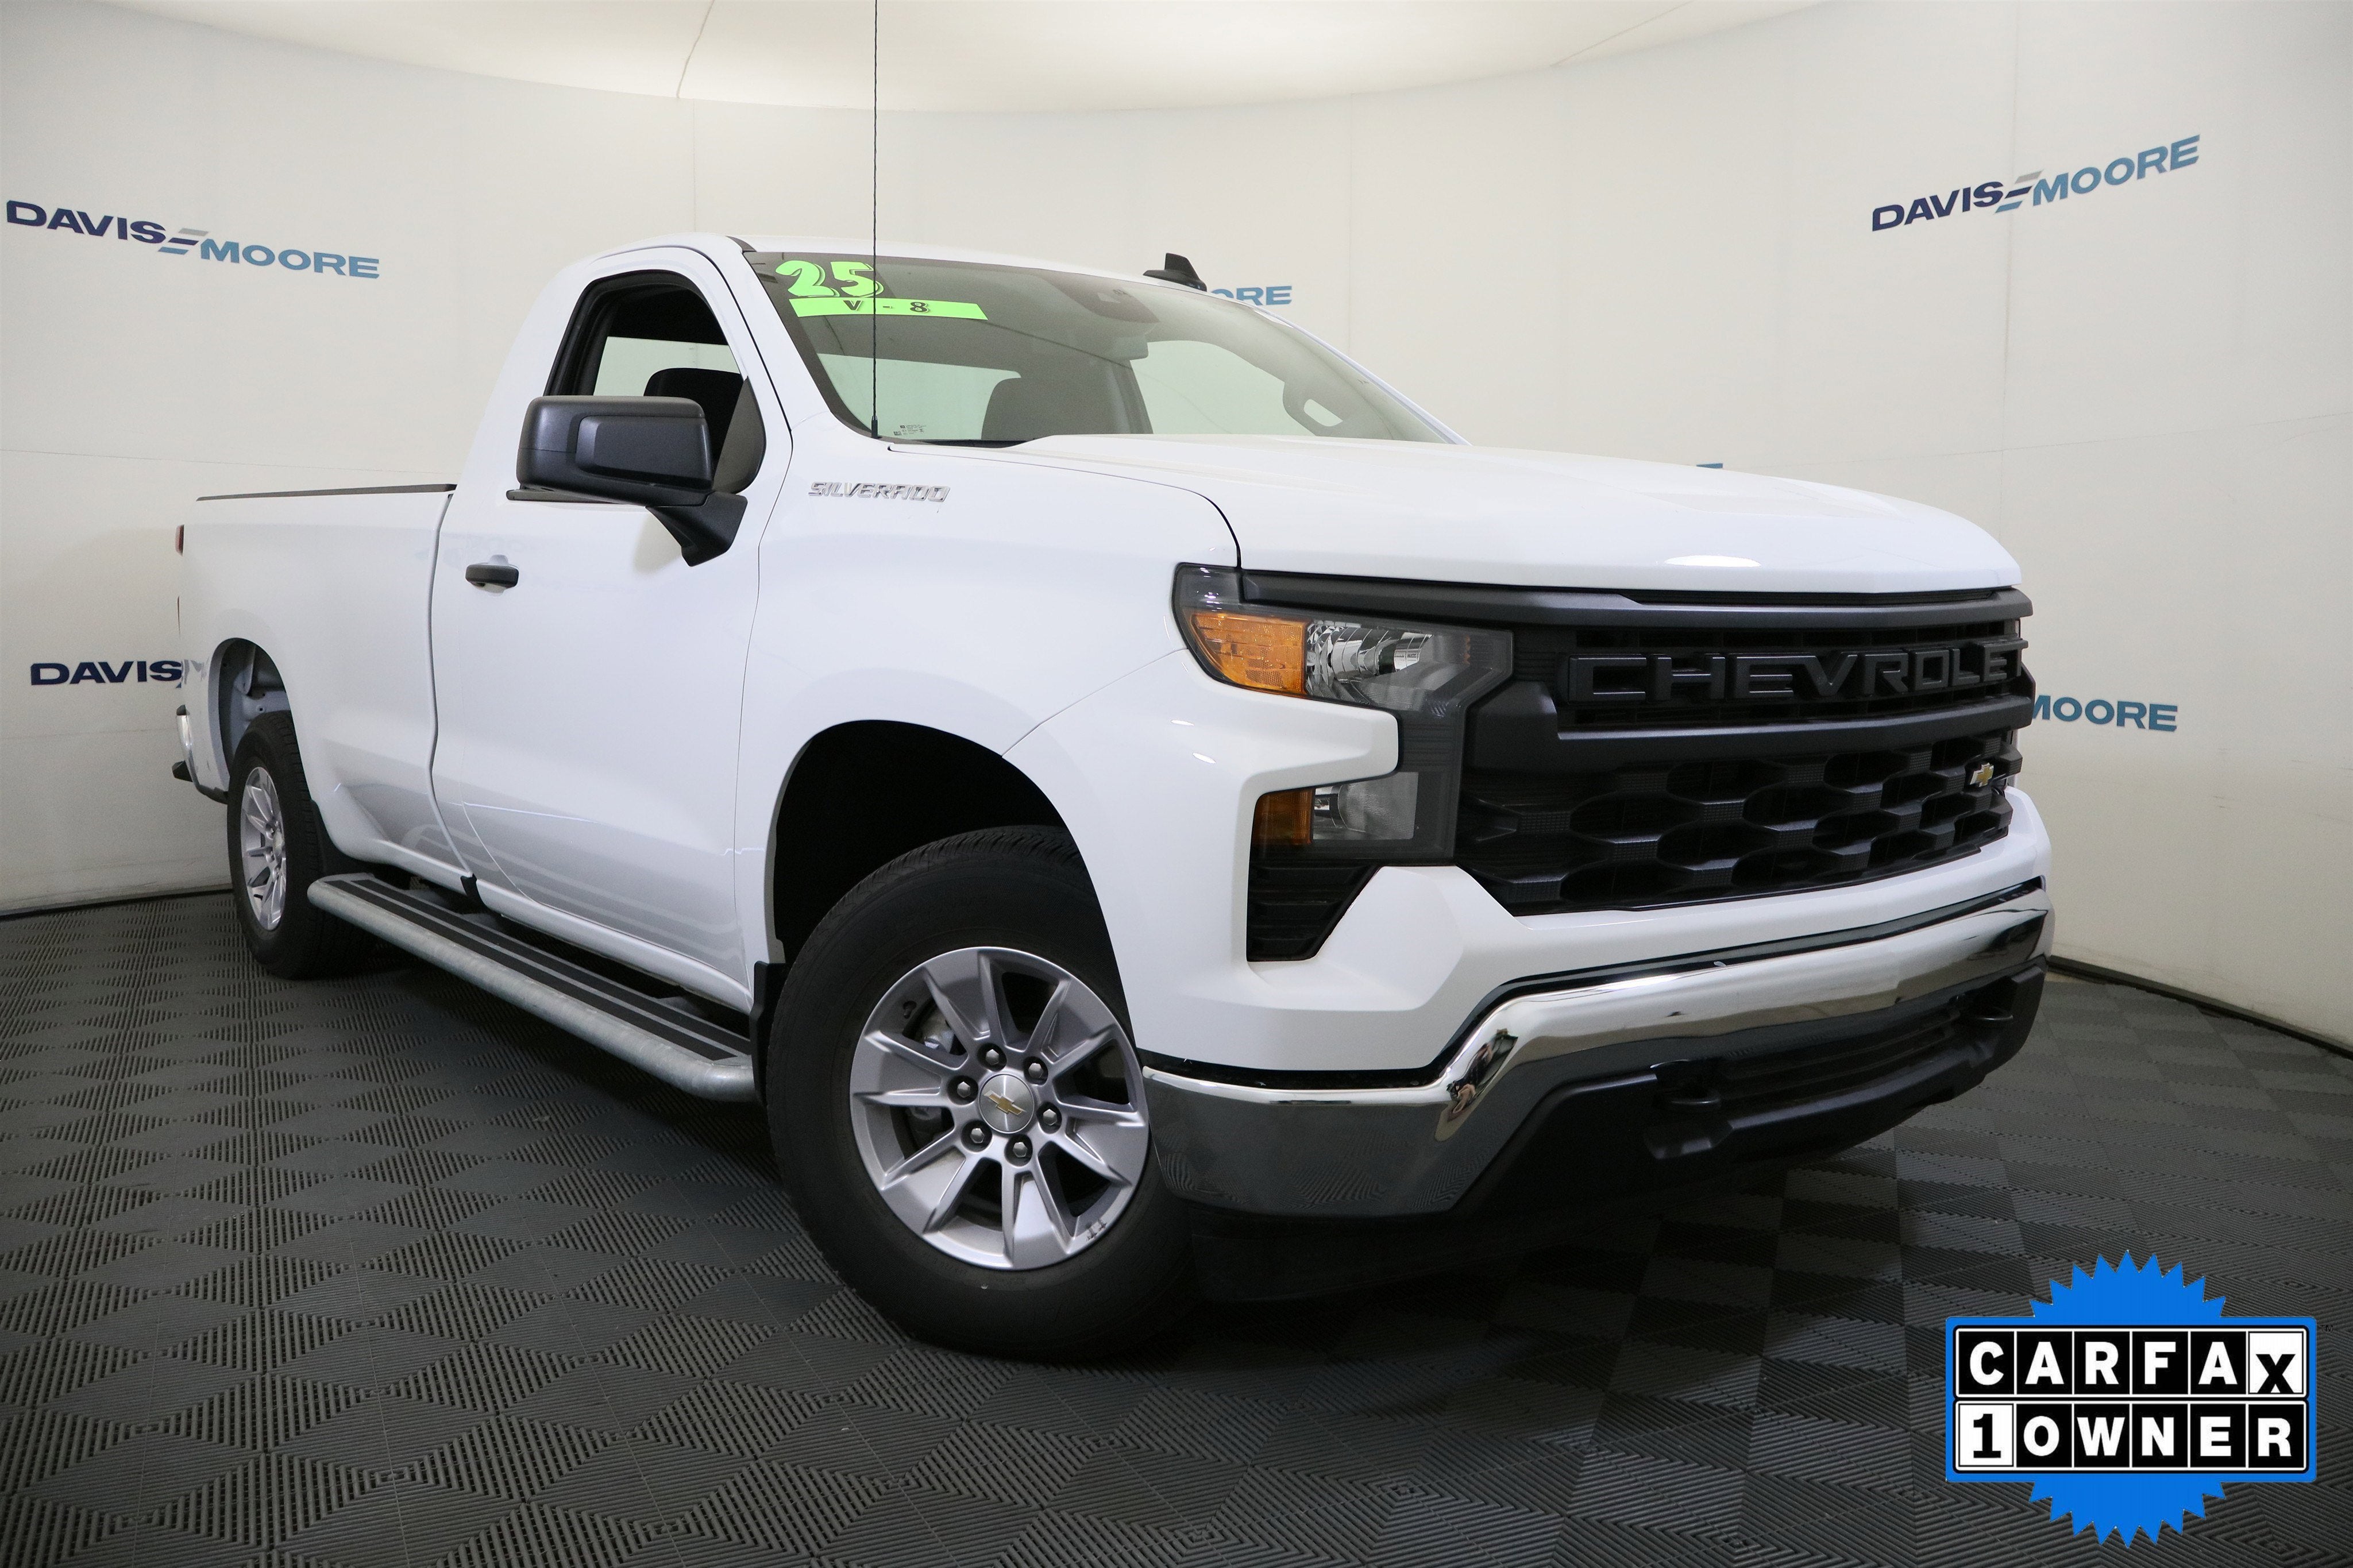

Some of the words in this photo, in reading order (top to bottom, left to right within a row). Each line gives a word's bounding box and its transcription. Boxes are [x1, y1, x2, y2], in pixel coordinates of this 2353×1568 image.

[1872, 181, 2004, 232] DAVIS
[2032, 134, 2201, 207] MOORE
[6, 200, 166, 244] DAVIS
[200, 238, 380, 279] MOORE
[776, 260, 884, 298] 25
[808, 481, 951, 503] SILVERADO
[30, 661, 182, 686] DAVIS
[1567, 639, 2029, 704] CHEVROLET
